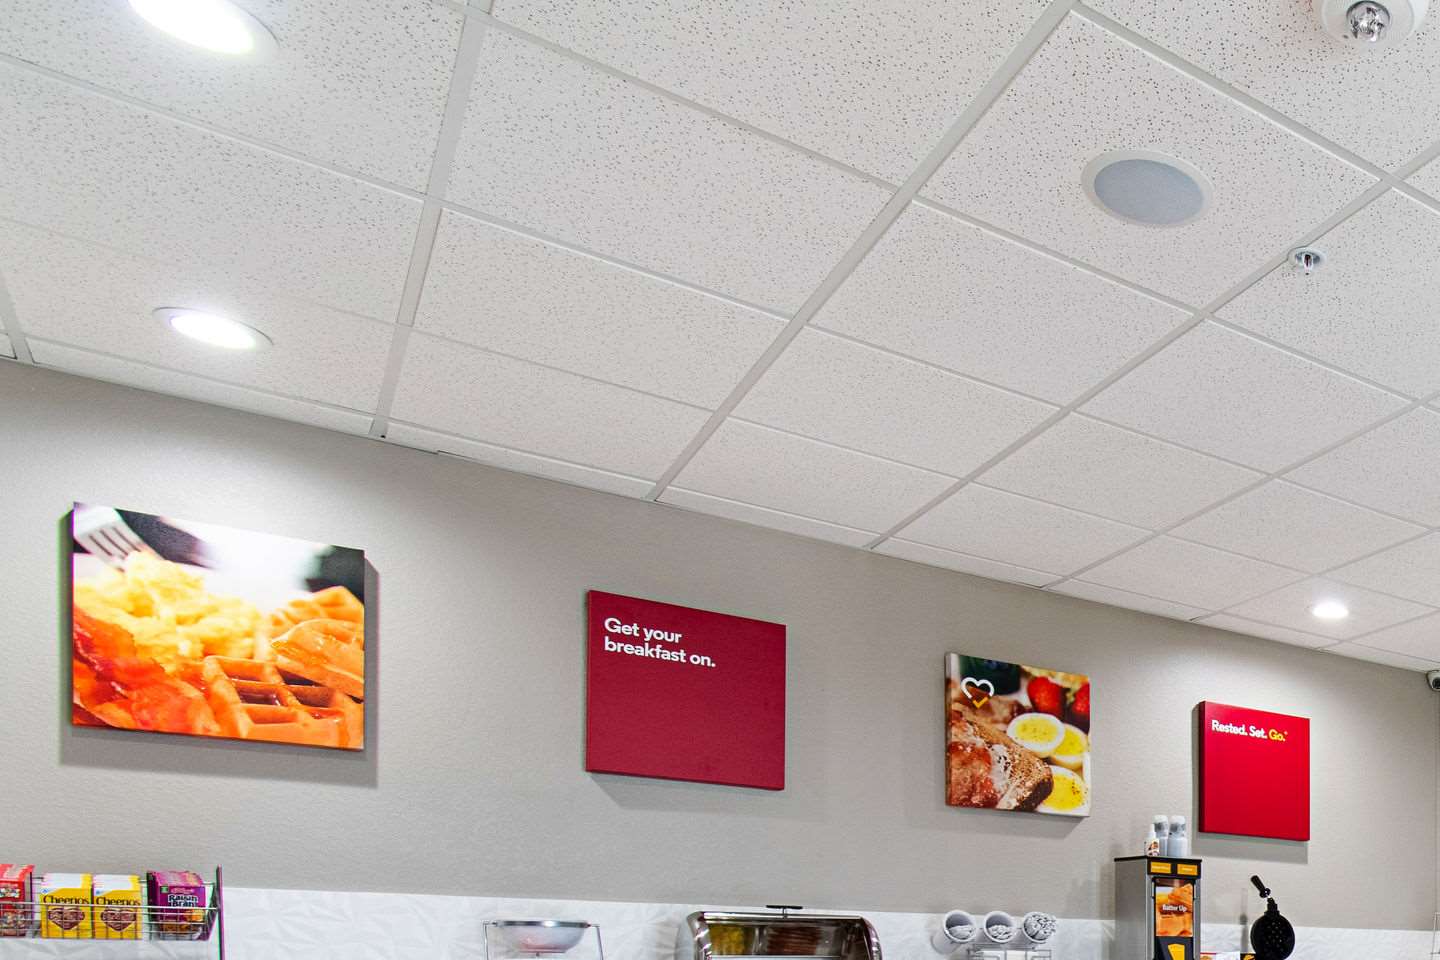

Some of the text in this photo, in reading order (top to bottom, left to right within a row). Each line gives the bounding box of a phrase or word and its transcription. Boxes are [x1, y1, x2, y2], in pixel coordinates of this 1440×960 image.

[604, 617, 682, 643] Get your
[604, 635, 716, 667] breakfast on.
[1211, 719, 1286, 742] Rested. Set. Go.
[43, 895, 90, 905] Cheerios
[96, 896, 141, 906] Cheerios
[168, 894, 198, 903] Raisin
